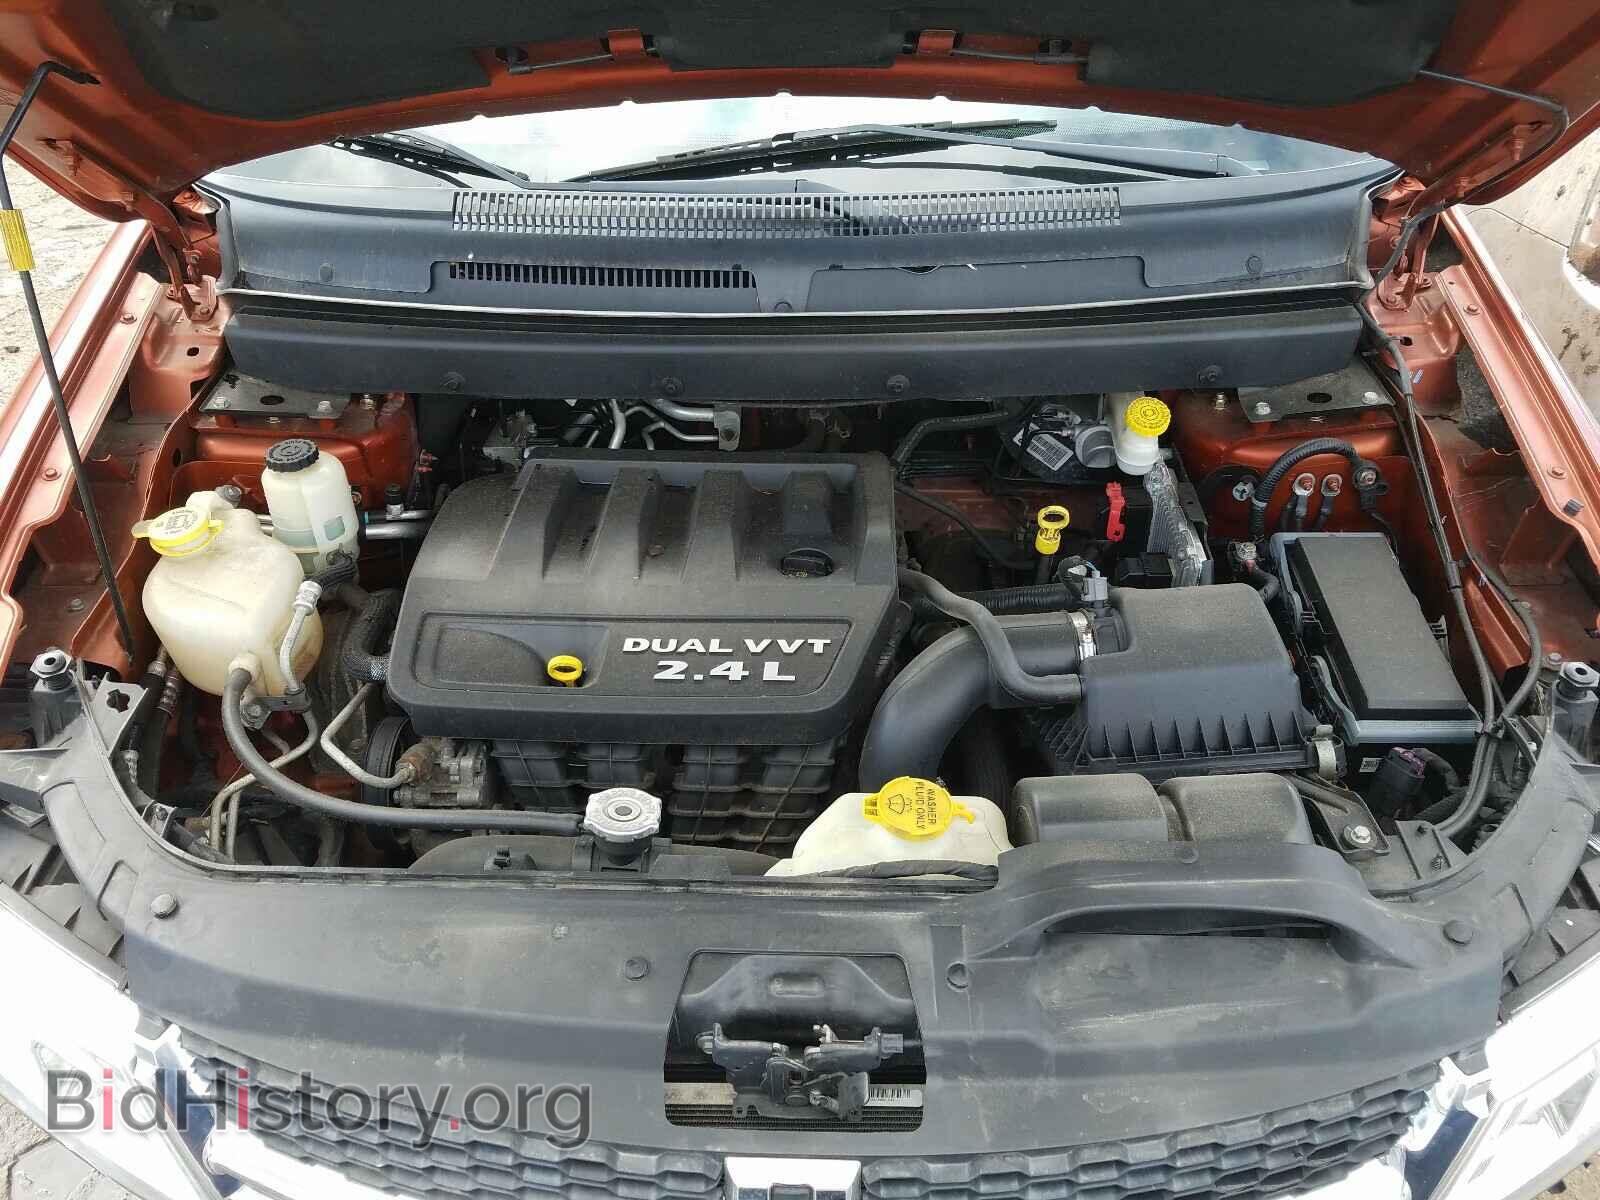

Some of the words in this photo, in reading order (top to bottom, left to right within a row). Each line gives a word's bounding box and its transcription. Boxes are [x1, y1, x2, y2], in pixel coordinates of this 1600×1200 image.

[622, 637, 734, 654] DUAL
[743, 638, 832, 655] VVT
[653, 660, 750, 682] 2.4
[762, 661, 796, 682] L
[915, 781, 926, 805] FLUID
[927, 788, 938, 825] WASHER
[915, 807, 927, 830] ONLY
